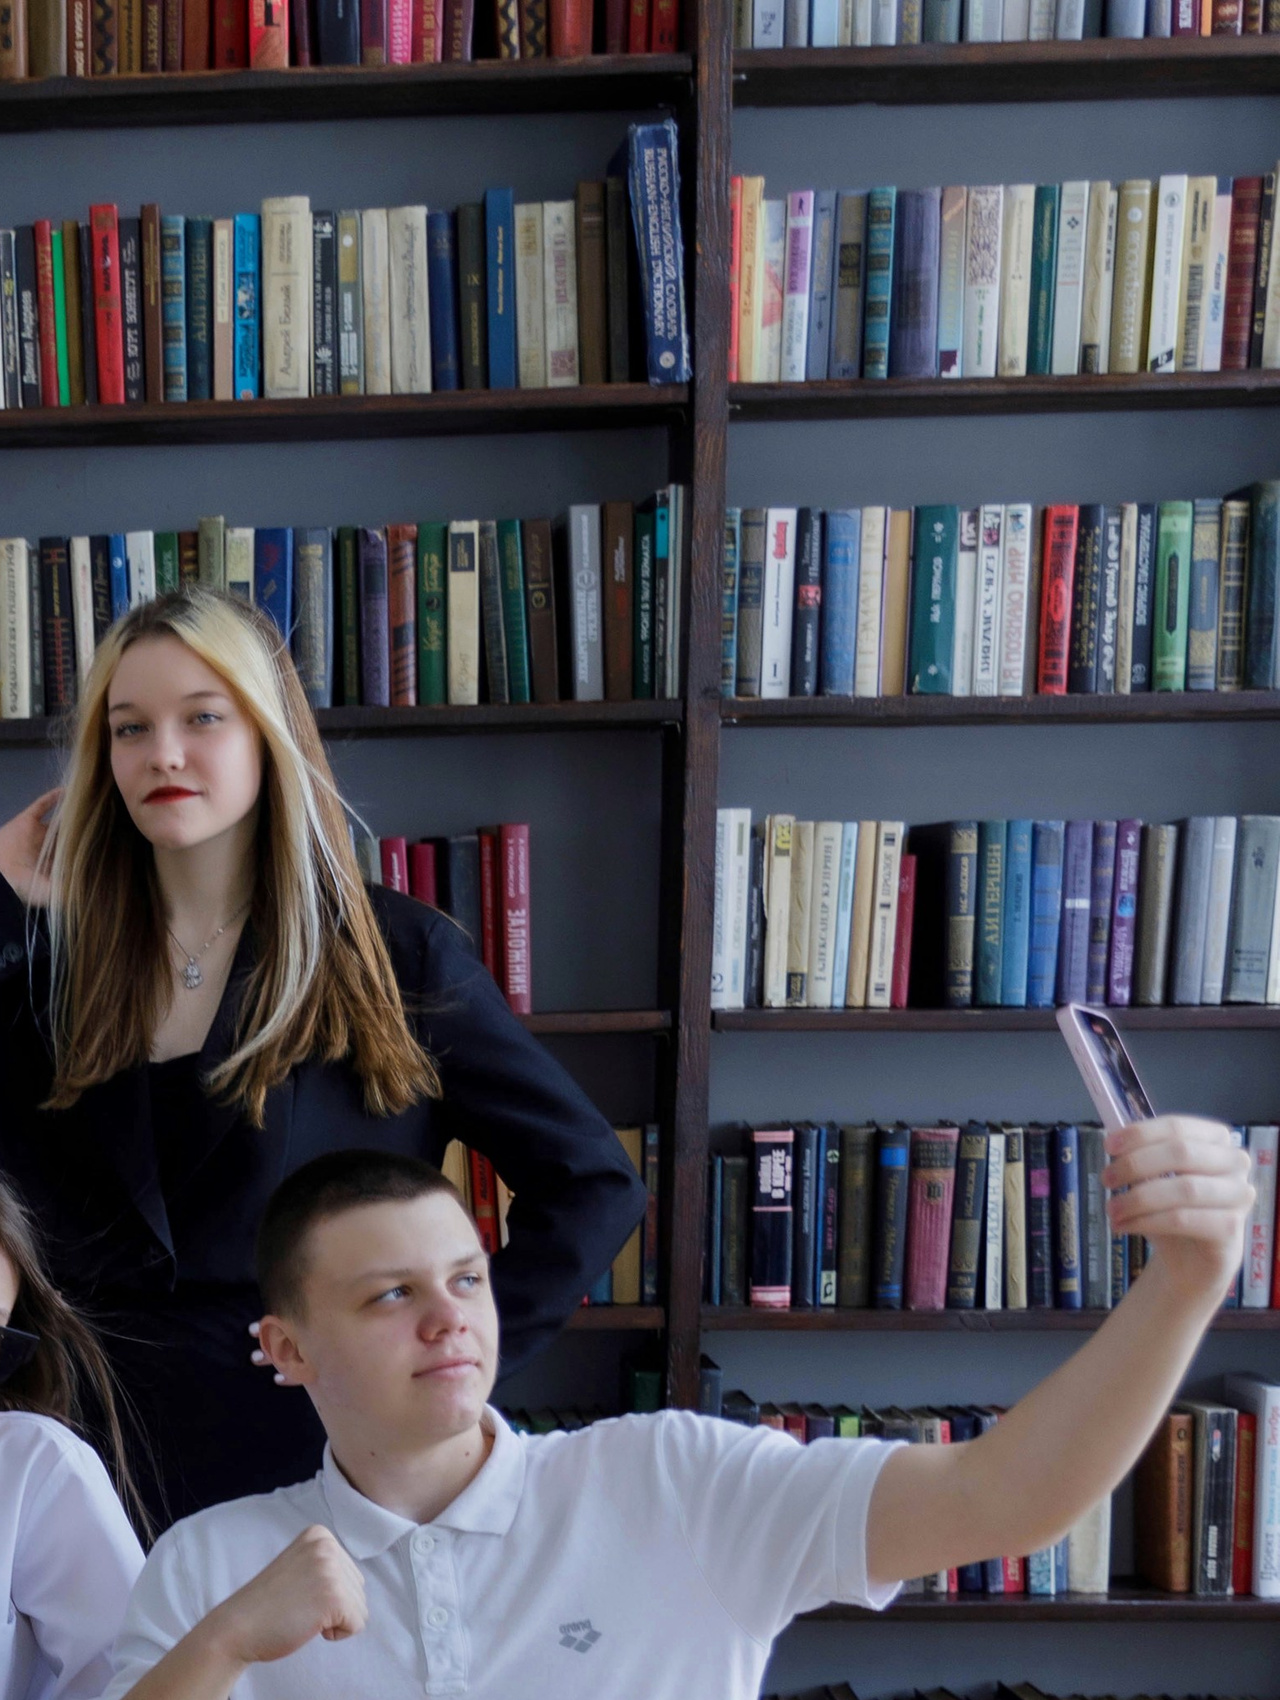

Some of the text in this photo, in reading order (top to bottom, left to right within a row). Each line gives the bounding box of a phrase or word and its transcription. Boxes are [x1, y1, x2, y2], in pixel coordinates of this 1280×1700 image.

[643, 148, 666, 338] RUSSIAN-ENGLISH DICTIONARY
[657, 147, 678, 341] РУССКО-АНГЛИЙСКИЙ СЛОВАРЬ
[278, 284, 293, 375] Андрей Белый
[1006, 546, 1023, 681] Я ПОЗНАЮ МИР
[506, 908, 527, 995] ЗАЛОЖНИК
[757, 1155, 772, 1194] ВОЙНА
[771, 1149, 786, 1199] В КОРЕЕ
[1267, 1405, 1280, 1446] DevOps
[1260, 1533, 1276, 1581] Проект
[558, 1619, 593, 1635] arena
